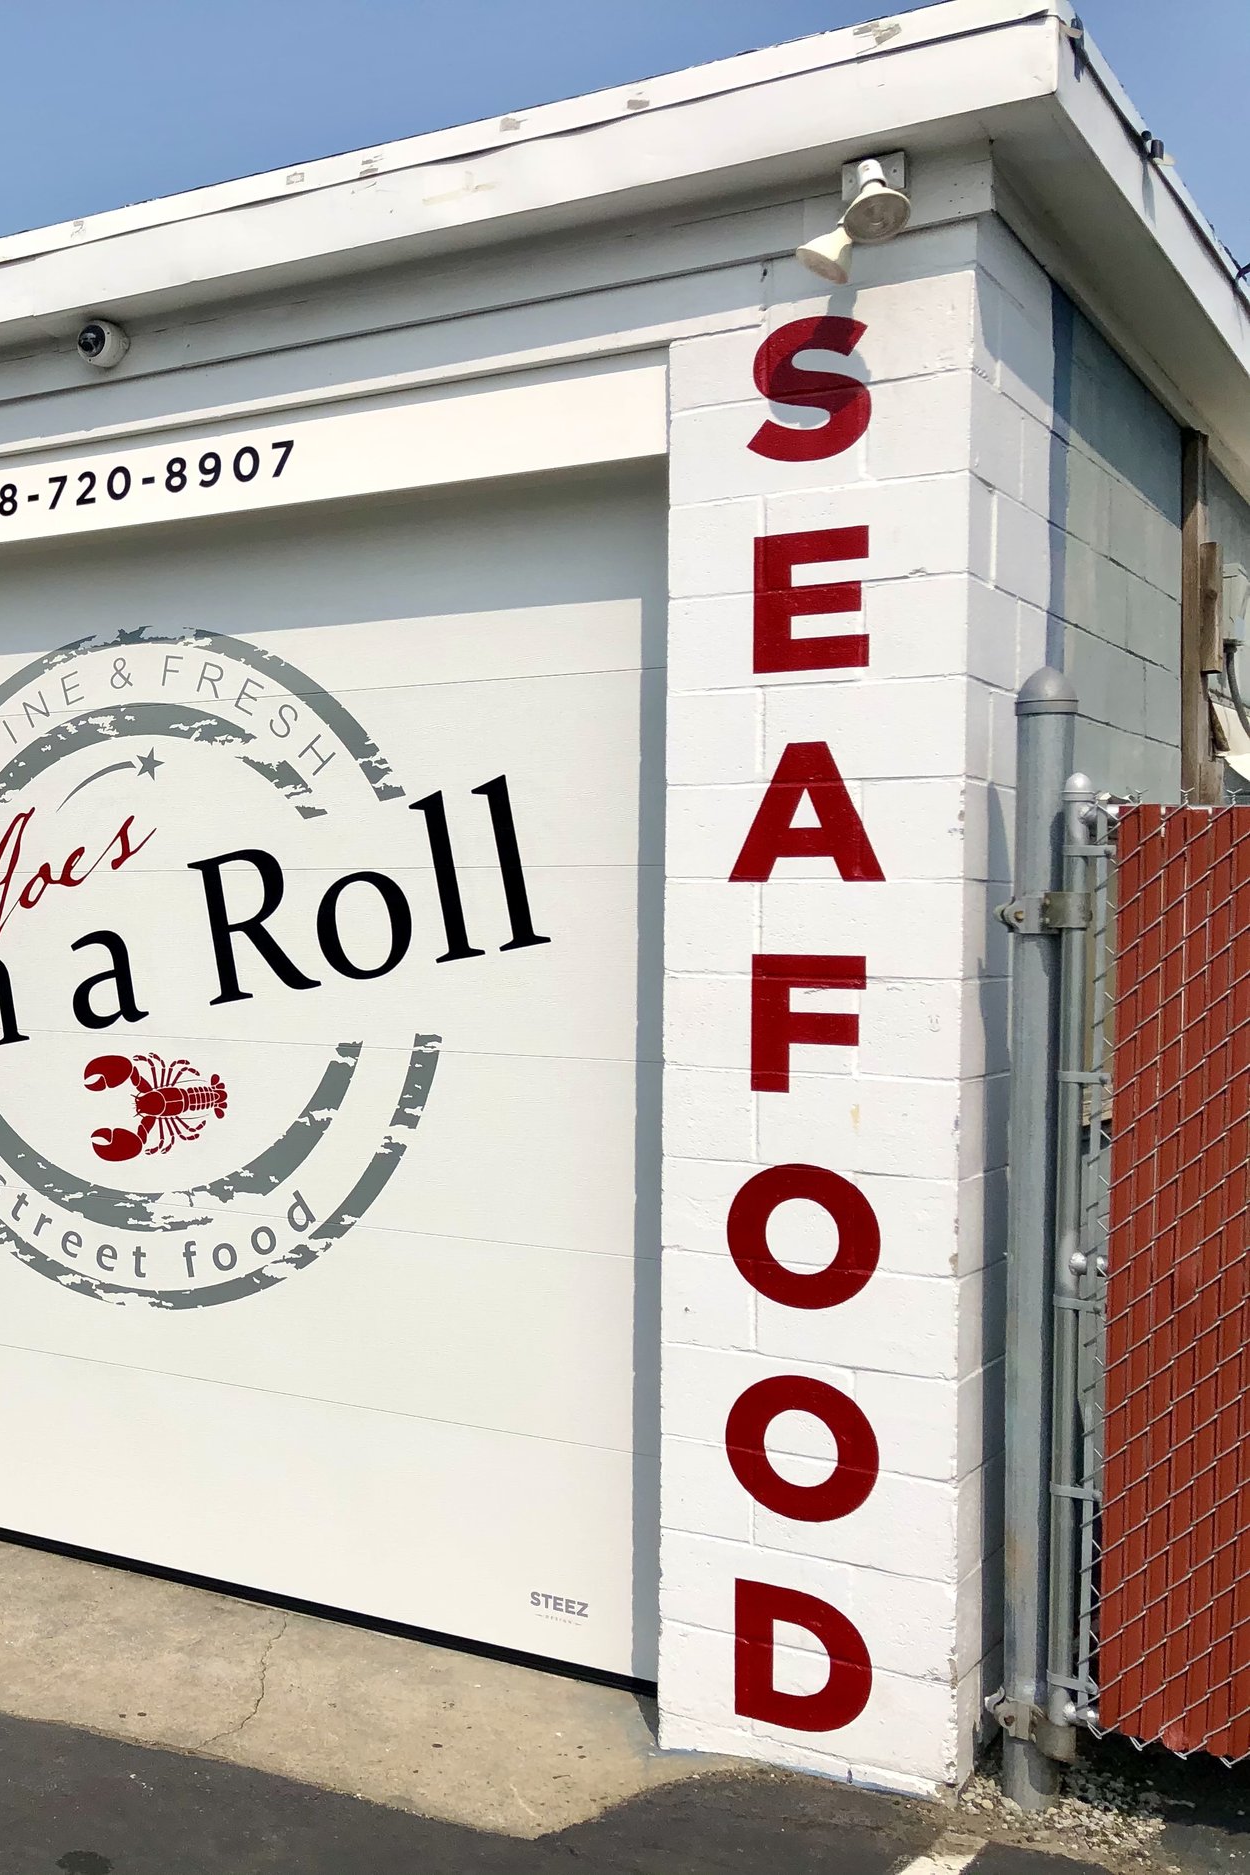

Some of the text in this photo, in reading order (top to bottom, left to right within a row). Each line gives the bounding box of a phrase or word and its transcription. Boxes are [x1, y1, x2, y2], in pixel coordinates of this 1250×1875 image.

[110, 657, 133, 689] &
[161, 655, 336, 776] FRESH
[71, 930, 149, 1029] a
[187, 774, 552, 1006] Roll
[725, 316, 885, 1732] SEAFOOD
[183, 1190, 316, 1277] food
[530, 1591, 589, 1618] STEEZ
